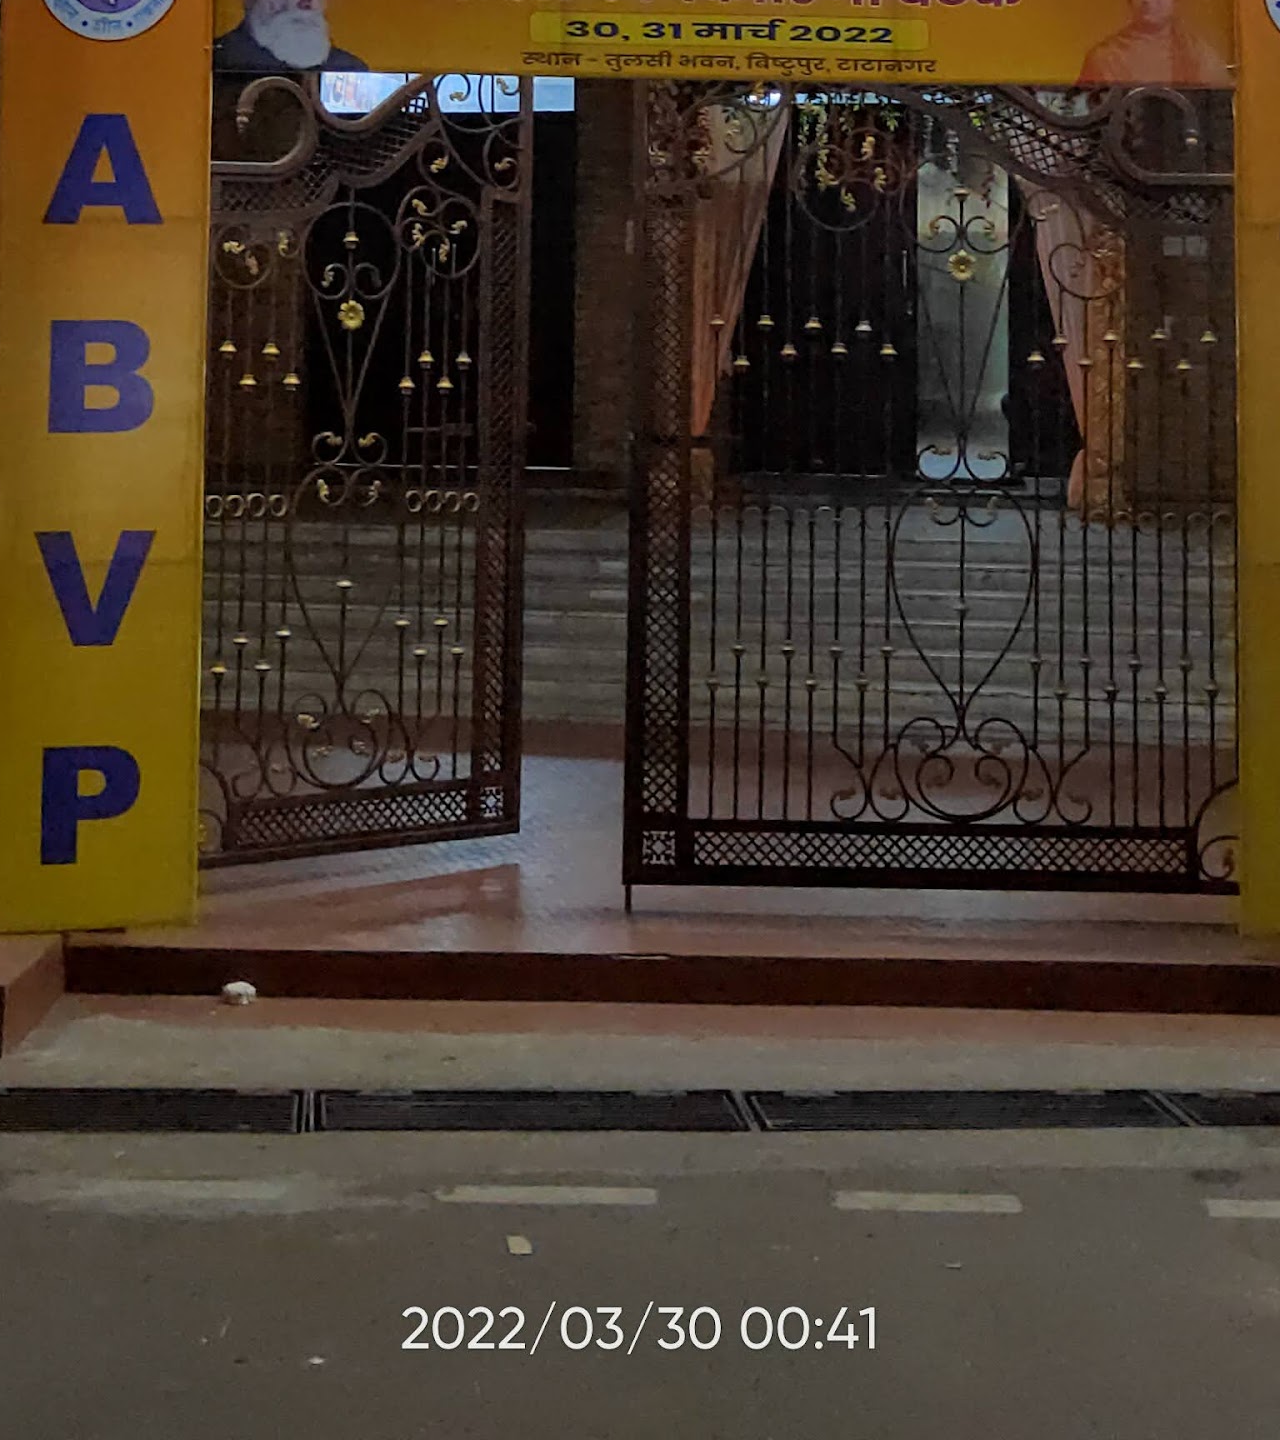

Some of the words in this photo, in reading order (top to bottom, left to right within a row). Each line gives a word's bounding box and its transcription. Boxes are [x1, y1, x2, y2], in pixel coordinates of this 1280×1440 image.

[566, 20, 630, 41] 30,
[643, 21, 682, 40] 31
[692, 18, 786, 42] मार्च
[789, 24, 893, 44] 2022
[521, 50, 582, 67] स्थान
[603, 50, 672, 73] तुलसी
[836, 57, 939, 74] टाटानगर
